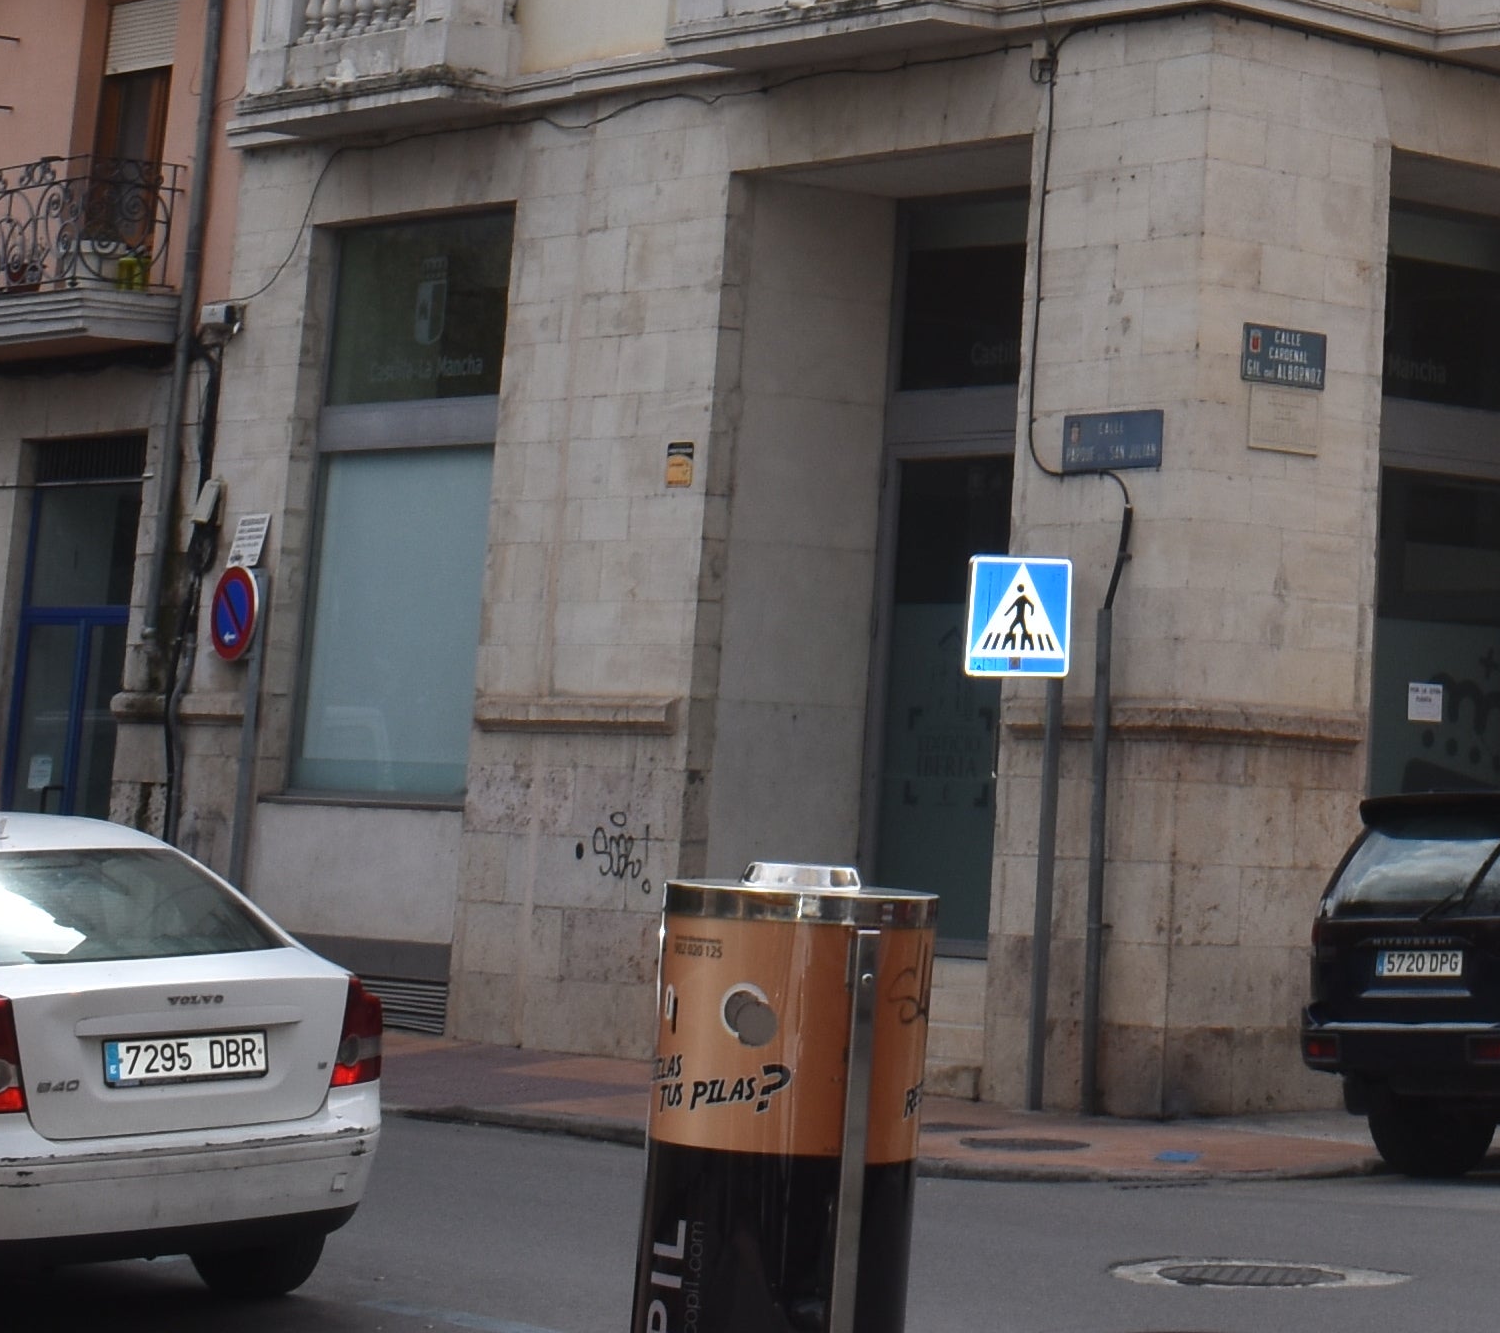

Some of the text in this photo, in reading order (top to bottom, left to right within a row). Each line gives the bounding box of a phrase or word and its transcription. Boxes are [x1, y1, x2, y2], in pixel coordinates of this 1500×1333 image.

[1274, 329, 1302, 347] CALLE
[1268, 345, 1307, 365] CARDENAL
[1246, 358, 1261, 377] GIL
[1277, 363, 1322, 385] ALBORNOZ
[1387, 953, 1459, 973] 5720 DPG
[167, 994, 224, 1006] VOLVO
[125, 1038, 257, 1076] 7295 DBR
[660, 1081, 683, 1113] TUS
